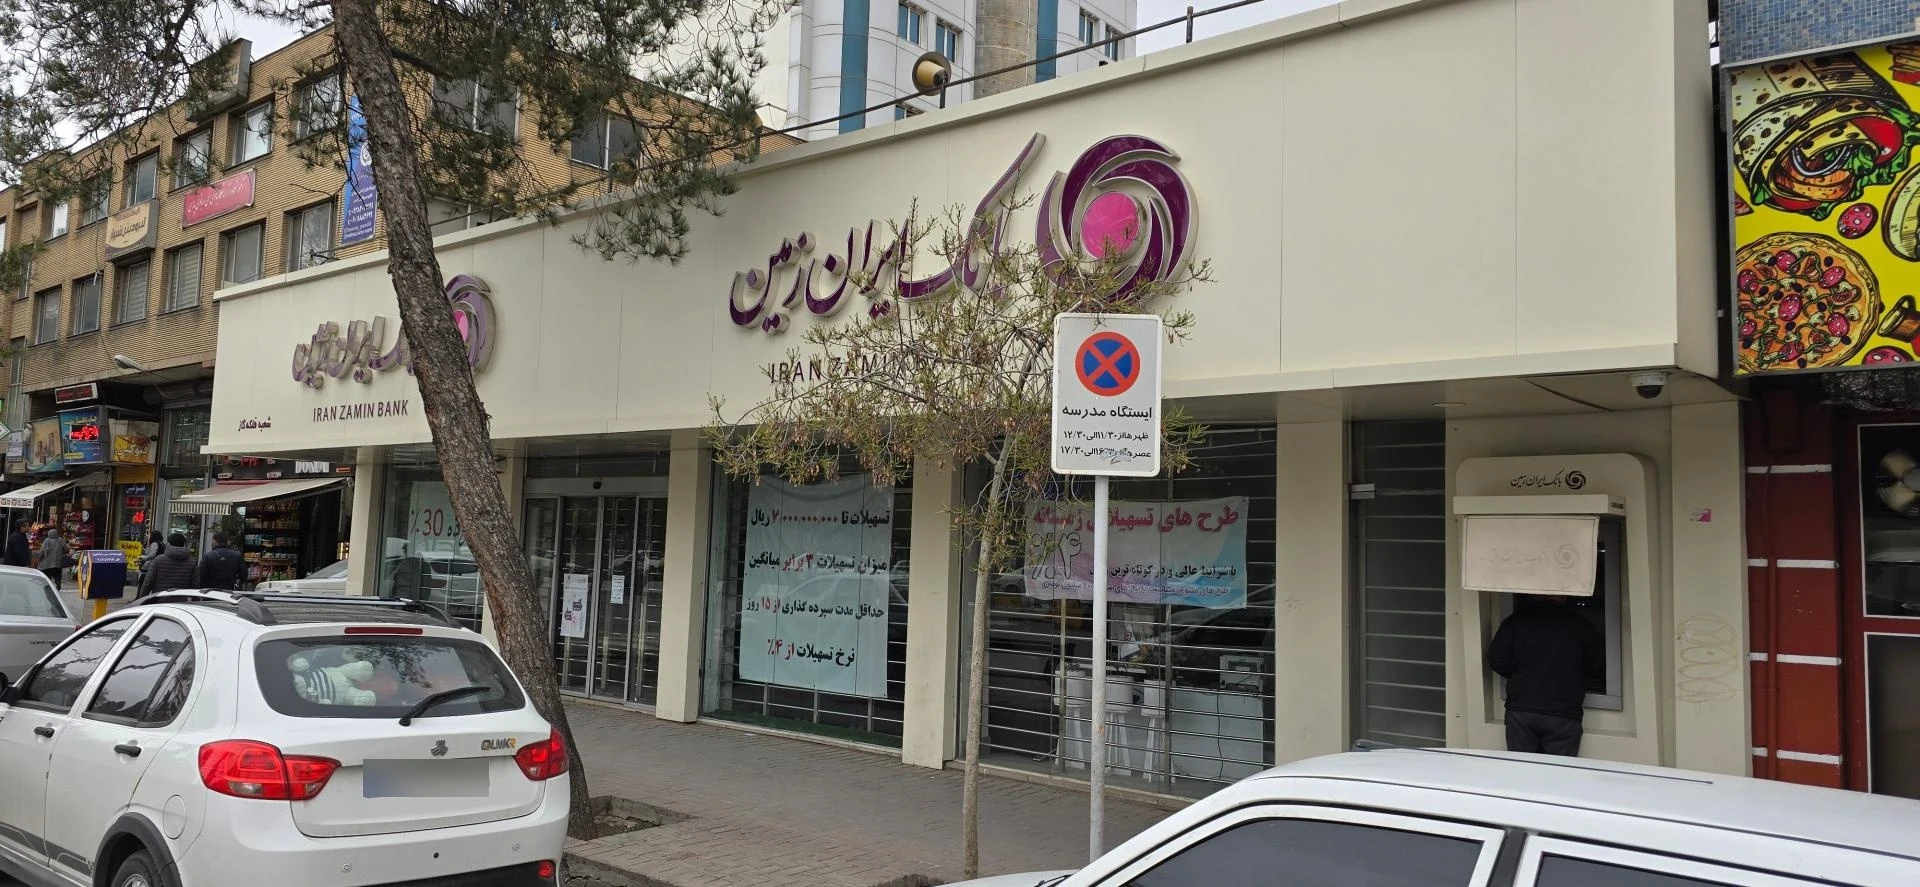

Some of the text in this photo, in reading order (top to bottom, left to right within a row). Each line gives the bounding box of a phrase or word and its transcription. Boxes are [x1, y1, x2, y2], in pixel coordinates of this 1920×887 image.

[805, 218, 912, 321] ایران
[729, 230, 817, 336] زمین
[770, 358, 821, 384] IRAN
[313, 399, 409, 423] IRAN ZAMIN BANK
[1062, 405, 1152, 422] ایستگاه مدرسه
[1510, 468, 1565, 488] بانک ایران زمین
[751, 507, 770, 527] ریال
[841, 509, 849, 525] تا
[850, 509, 890, 528] تسهیلات
[1158, 506, 1192, 533] های
[1197, 504, 1239, 532] طرح
[749, 551, 887, 575] میزان تسهیلات ۳ برابر میانگین
[1110, 563, 1130, 577] ترین
[1131, 564, 1153, 578] کوتاه
[1175, 564, 1198, 578] عالی
[1167, 568, 1173, 579] و
[1200, 564, 1229, 580] شرایط
[746, 598, 760, 611] روز
[761, 597, 771, 610] ۱۵
[772, 598, 781, 613] از
[808, 602, 833, 618] سپرده
[835, 605, 854, 616] مدت
[855, 603, 885, 620] حداقل
[785, 642, 795, 660] از
[796, 643, 833, 663] تسهیلات
[835, 647, 855, 667] نرخ
